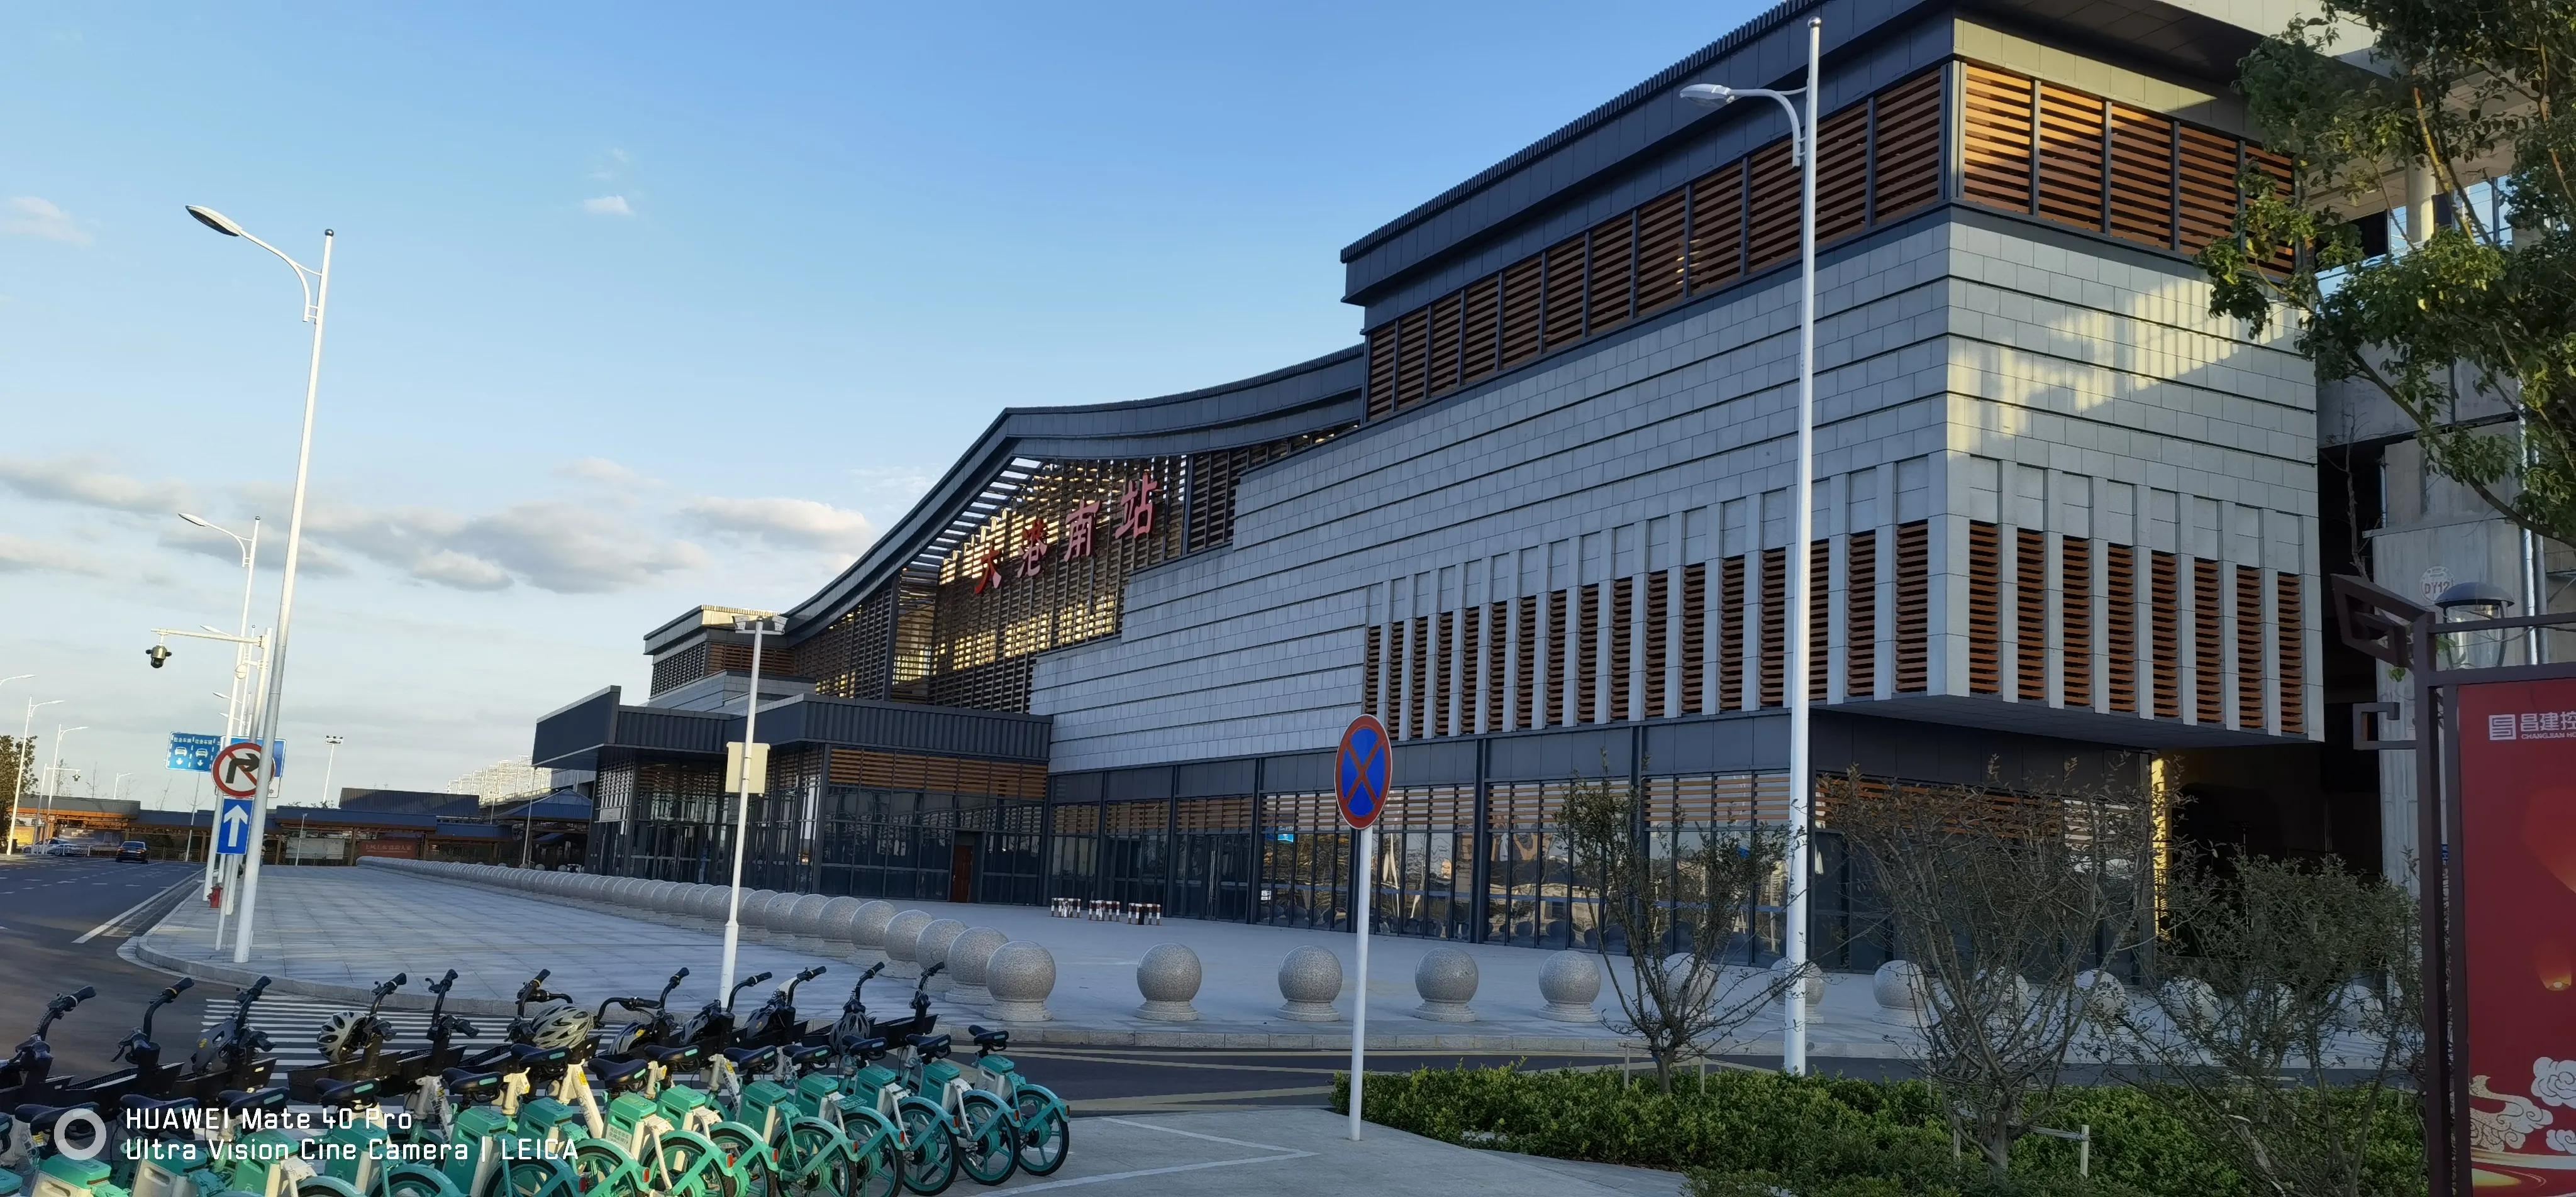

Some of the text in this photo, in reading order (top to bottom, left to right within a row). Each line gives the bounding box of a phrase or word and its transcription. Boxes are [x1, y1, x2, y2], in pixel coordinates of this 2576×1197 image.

[975, 473, 1157, 593] 大港南站
[2520, 711, 2576, 732] 昌建控
